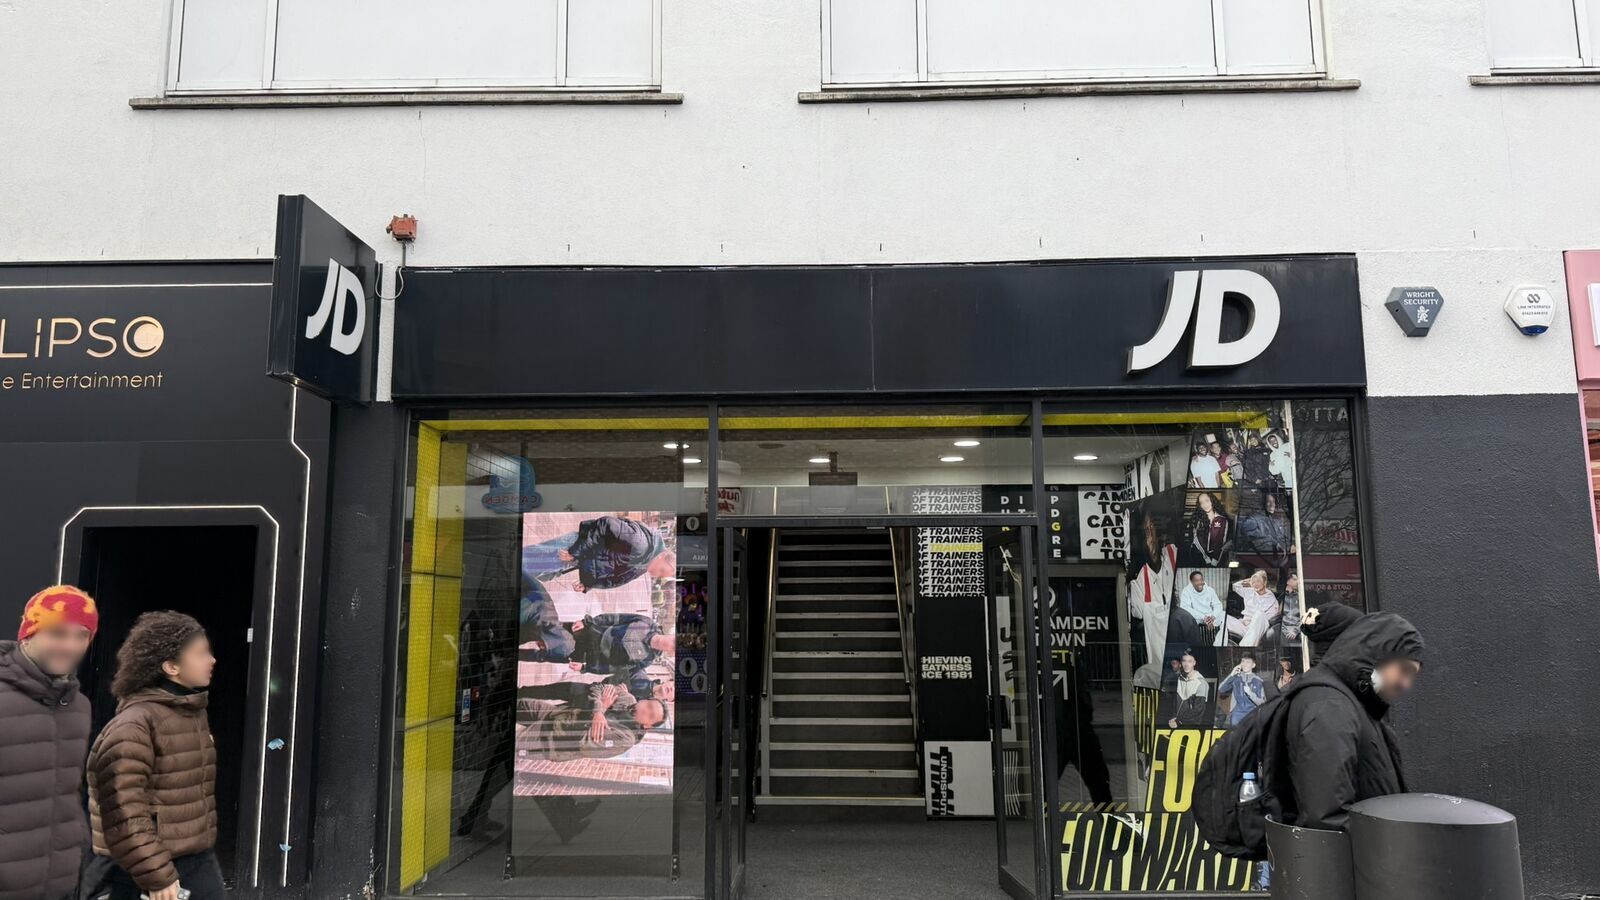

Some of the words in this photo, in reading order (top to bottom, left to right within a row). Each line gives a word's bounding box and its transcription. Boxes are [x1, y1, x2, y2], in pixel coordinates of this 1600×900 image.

[305, 257, 366, 355] JD
[1403, 298, 1439, 306] SECURITY
[1128, 269, 1281, 372] JD
[21, 371, 164, 389] Entertainment
[928, 487, 981, 495] TRAINERS
[928, 495, 982, 503] TRAINERS
[928, 503, 982, 511] TRAINERS
[930, 527, 983, 536] TRAINERS
[930, 535, 983, 543] TRAINERS
[930, 552, 984, 560] TRAINERS
[931, 560, 984, 568] TRAINERS
[931, 568, 984, 576] TRAINERS
[931, 576, 985, 584] TRAINERS
[932, 584, 985, 593] TRAINERS
[944, 671, 973, 679] 1981
